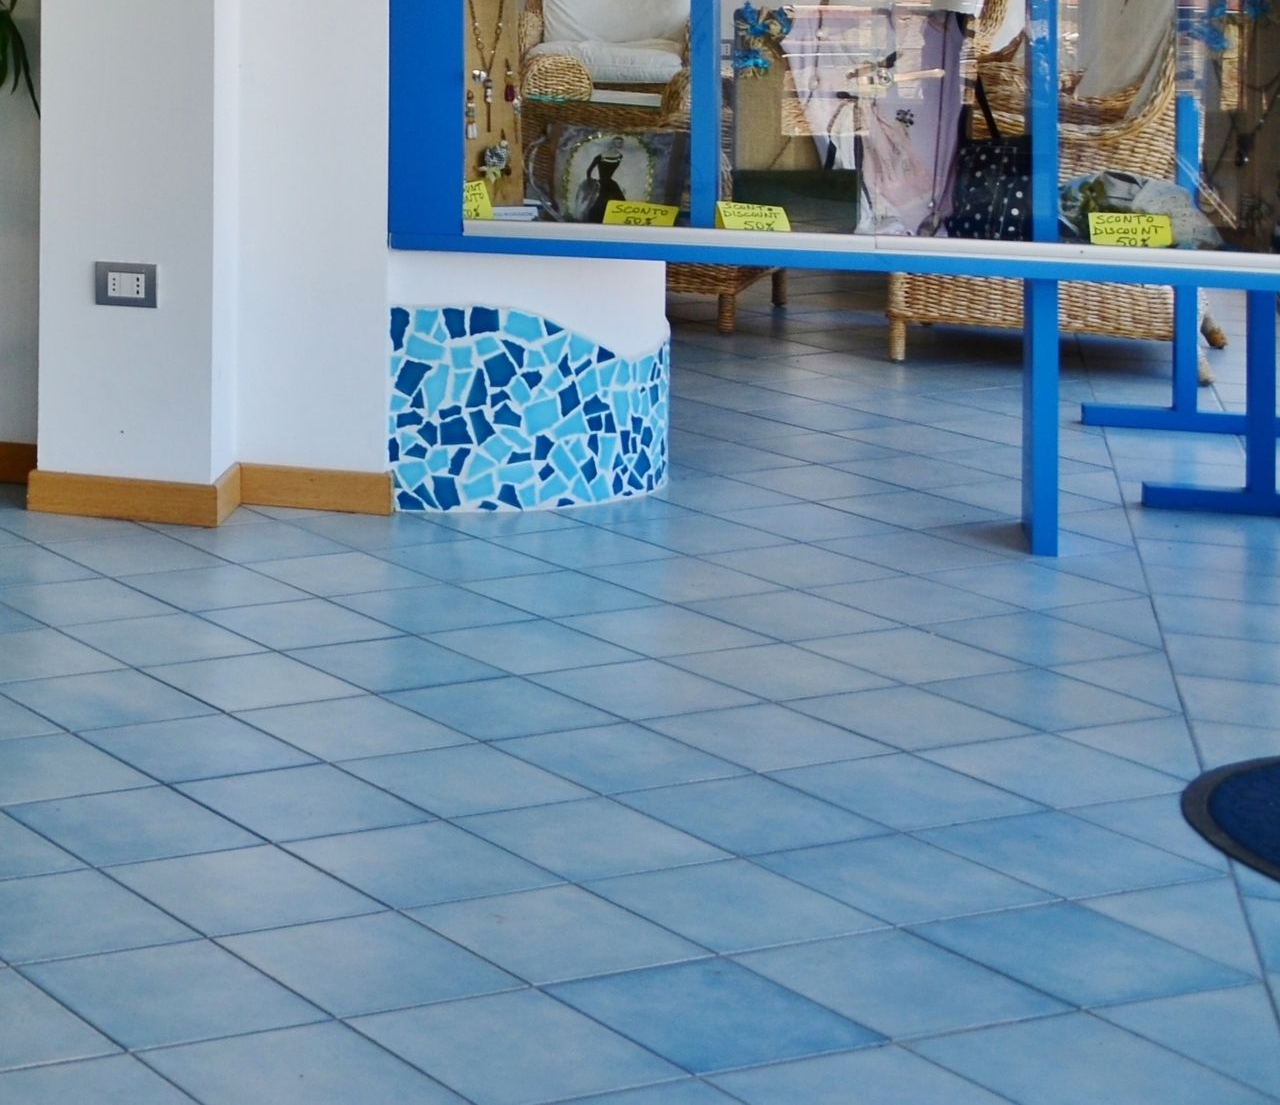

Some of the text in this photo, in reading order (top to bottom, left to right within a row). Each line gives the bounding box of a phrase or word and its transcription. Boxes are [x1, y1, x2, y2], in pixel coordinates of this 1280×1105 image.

[611, 204, 669, 216] SCONTO
[723, 209, 781, 219] DISCOUNT
[1095, 214, 1154, 225] SCONTO
[744, 220, 775, 231] 50%
[1092, 225, 1164, 236] DISCOUNT
[1116, 236, 1151, 247] 50%
